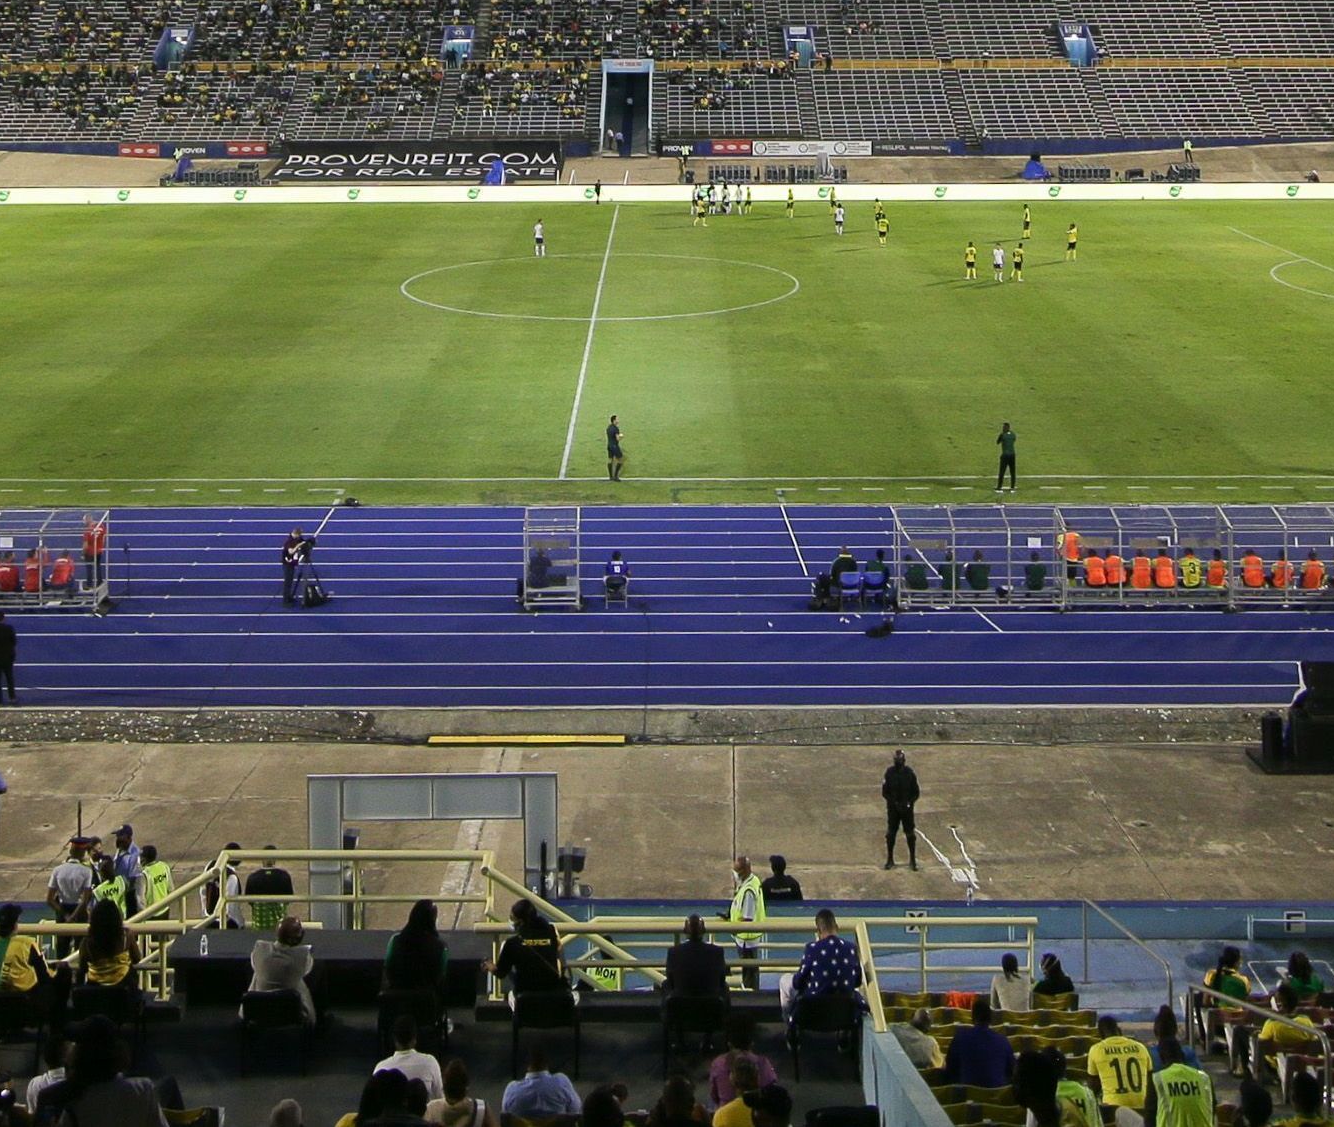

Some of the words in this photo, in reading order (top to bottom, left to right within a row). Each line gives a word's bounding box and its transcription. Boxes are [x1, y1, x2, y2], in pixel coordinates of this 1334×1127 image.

[285, 152, 557, 166] PROVENREIT.COM
[274, 168, 345, 176] FOR
[355, 168, 432, 176] REAL
[1189, 562, 1196, 574] 3
[1287, 914, 1303, 931] F
[1109, 1057, 1142, 1094] 10
[1167, 1081, 1201, 1097] MOH
